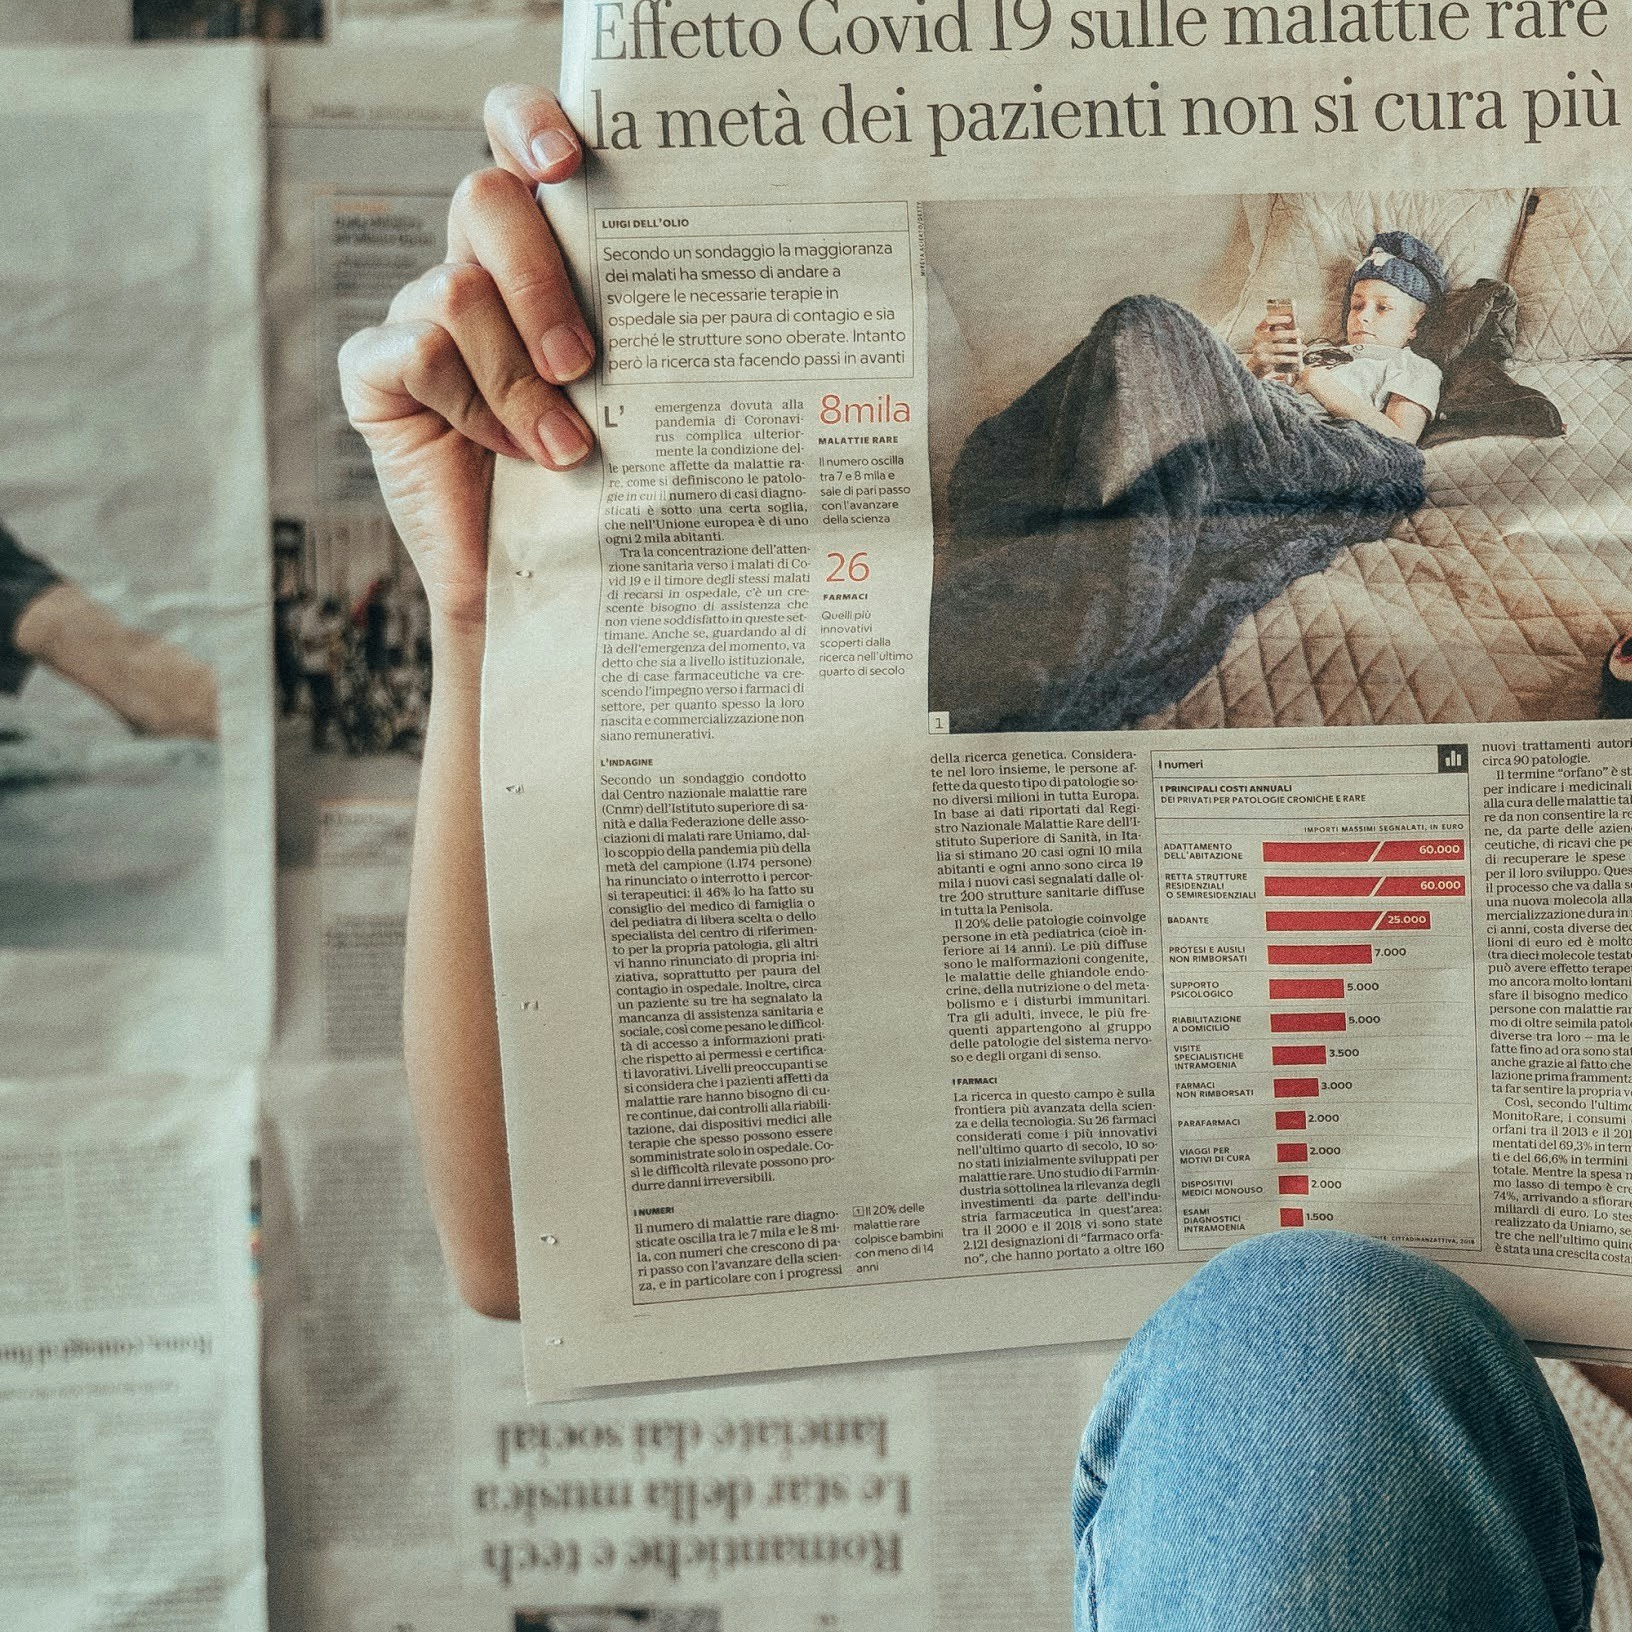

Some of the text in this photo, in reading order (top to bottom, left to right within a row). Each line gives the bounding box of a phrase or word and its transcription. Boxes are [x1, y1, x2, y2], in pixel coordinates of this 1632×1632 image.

[590, 67, 1621, 159] la metà dei pazienti non si cura più
[601, 218, 690, 230] LUIGI DELL'OLIO
[603, 242, 893, 262] Secondo un sondaggio la maggioranza
[818, 392, 912, 426] 8mila
[817, 435, 899, 445] MALATTIE RARE
[826, 551, 870, 582] 26
[822, 593, 869, 601] FARMACI
[1163, 759, 1204, 770] numeri
[1165, 784, 1218, 793] PRINCIPALI
[1219, 784, 1248, 793] COSTI
[1249, 784, 1293, 793] ANNUALI
[1419, 844, 1461, 855] 60.000
[1419, 880, 1461, 890] 60.000
[1386, 913, 1427, 925] 25.000
[1374, 947, 1407, 957] 7.000
[1347, 982, 1380, 992] 5.000
[1348, 1015, 1381, 1025] 5.000
[1329, 1048, 1360, 1058] 3.500
[1320, 1080, 1353, 1091] 3.000
[1307, 1113, 1340, 1124] 2.000
[1309, 1145, 1342, 1156] 2.000
[1311, 1179, 1343, 1190] 2.000
[1306, 1212, 1335, 1222] 1.500
[499, 1421, 623, 1468] social
[767, 1475, 849, 1510] star
[473, 1480, 633, 1526] musica
[644, 1479, 755, 1523] della
[482, 1531, 903, 1588] Romantiche e tech
